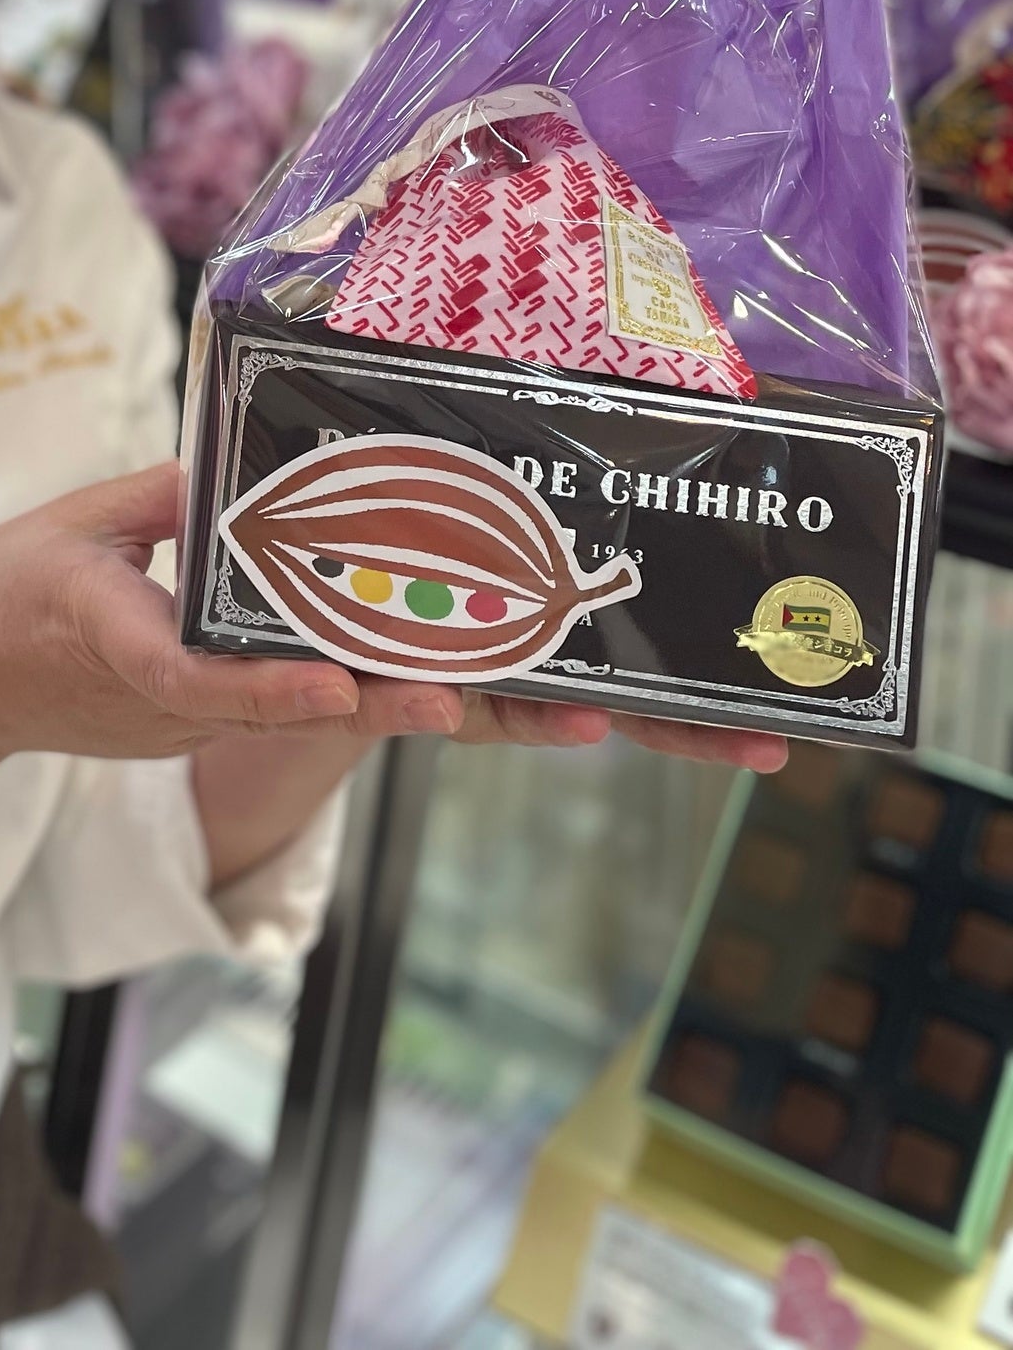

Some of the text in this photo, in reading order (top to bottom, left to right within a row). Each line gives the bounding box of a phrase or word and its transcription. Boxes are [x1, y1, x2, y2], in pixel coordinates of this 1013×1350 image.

[513, 454, 834, 533] DE CHIHIRO
[591, 543, 643, 564] 193
